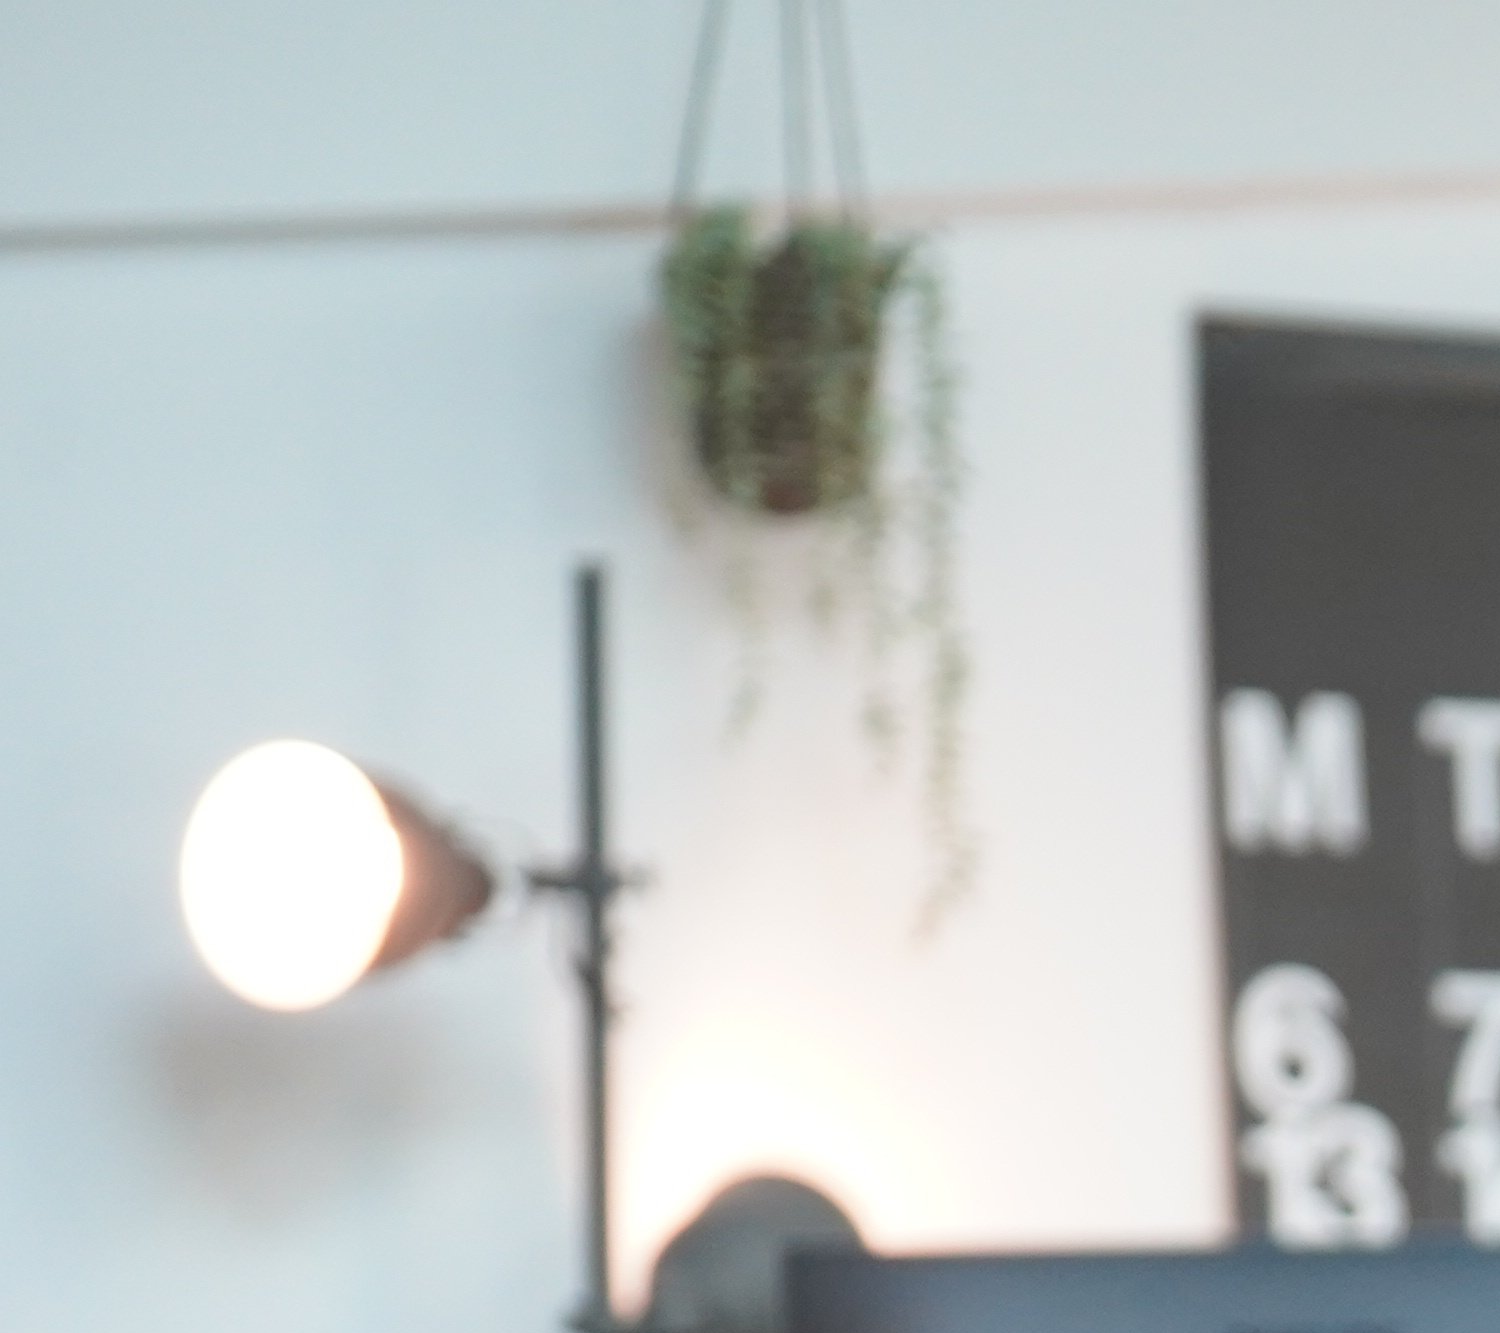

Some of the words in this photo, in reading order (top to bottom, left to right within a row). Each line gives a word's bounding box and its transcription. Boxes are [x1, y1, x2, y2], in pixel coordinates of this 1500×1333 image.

[1221, 689, 1366, 855] M
[1234, 964, 1352, 1118] 6
[1240, 1103, 1408, 1250] 13
